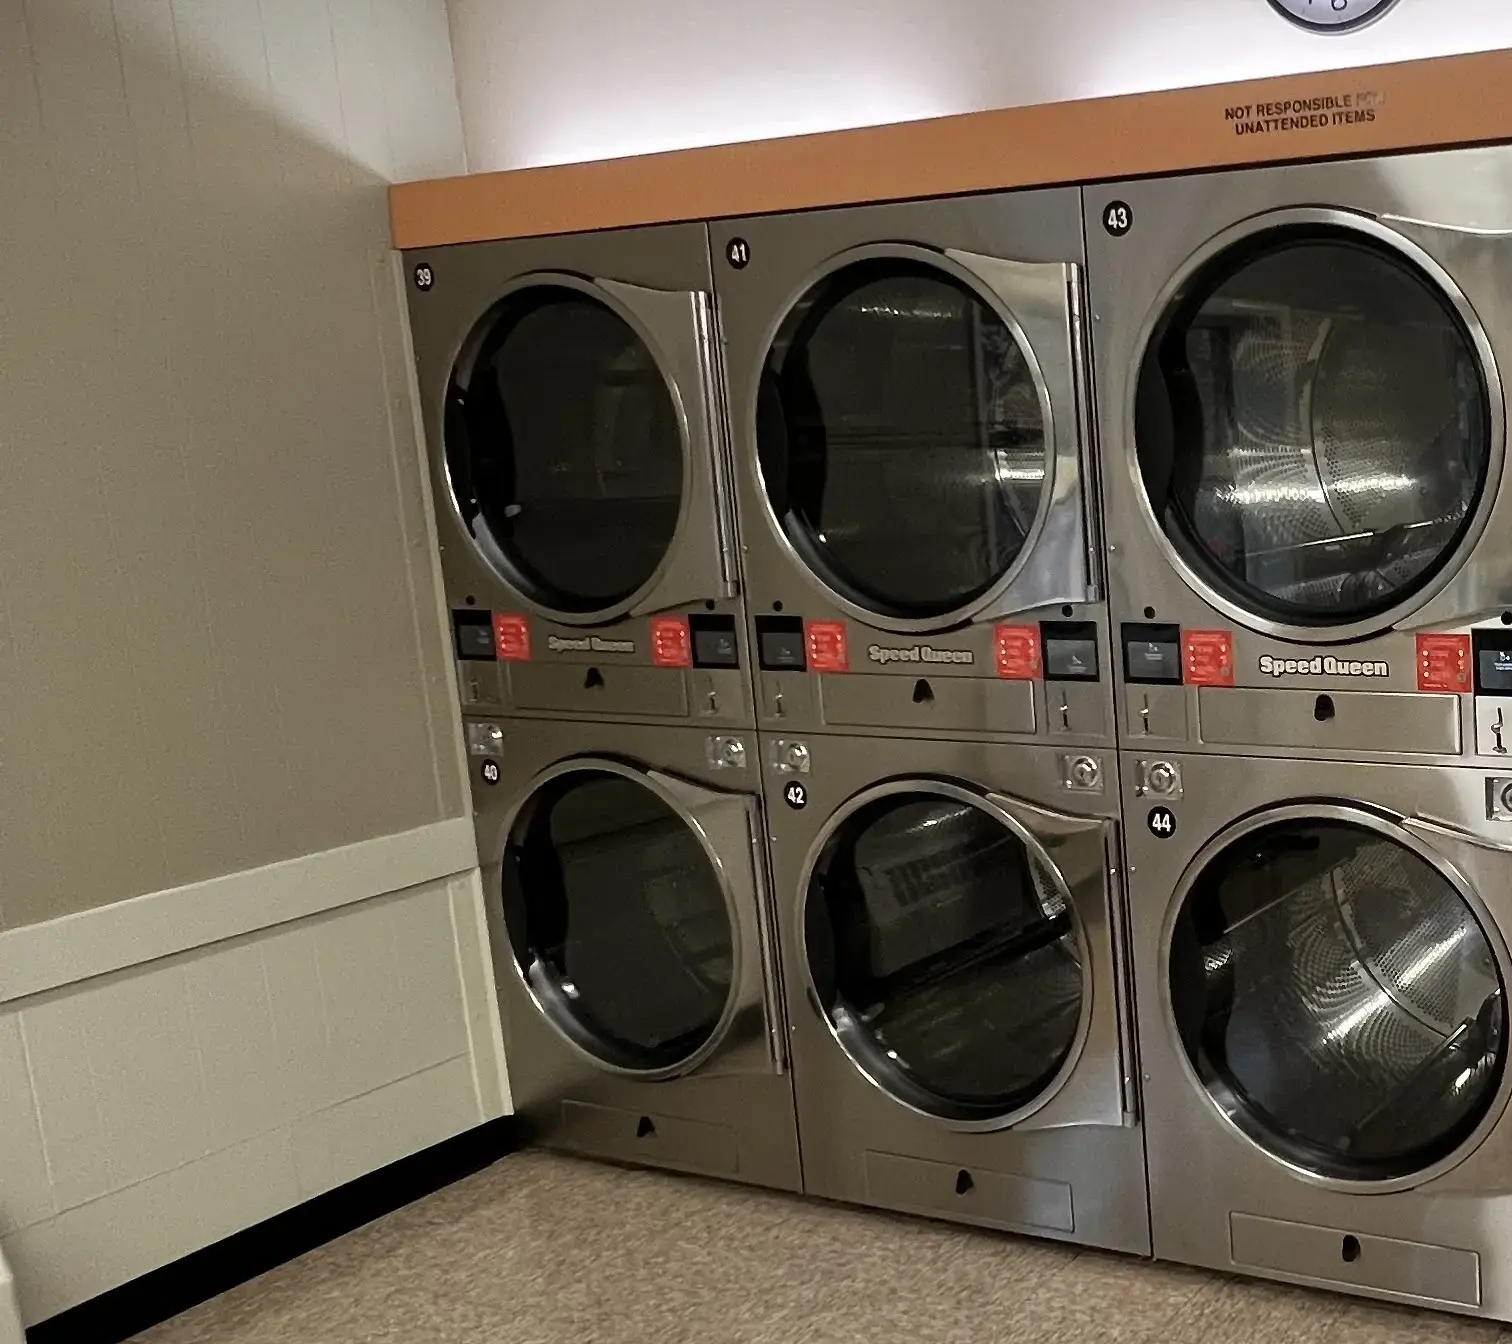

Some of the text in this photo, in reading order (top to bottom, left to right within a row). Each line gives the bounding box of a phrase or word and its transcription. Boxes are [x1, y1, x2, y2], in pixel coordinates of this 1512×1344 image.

[1224, 105, 1252, 121] NOT
[1256, 94, 1353, 117] RESPONSIBLE
[1235, 109, 1376, 135] UNATTENDED ITEMS
[1108, 207, 1128, 229] 43
[731, 243, 747, 262] 41
[416, 268, 431, 286] 39
[869, 644, 974, 664] Speed Queen
[1259, 655, 1389, 677] Speed Queen
[787, 786, 805, 803] 42
[1152, 812, 1172, 832] 44
